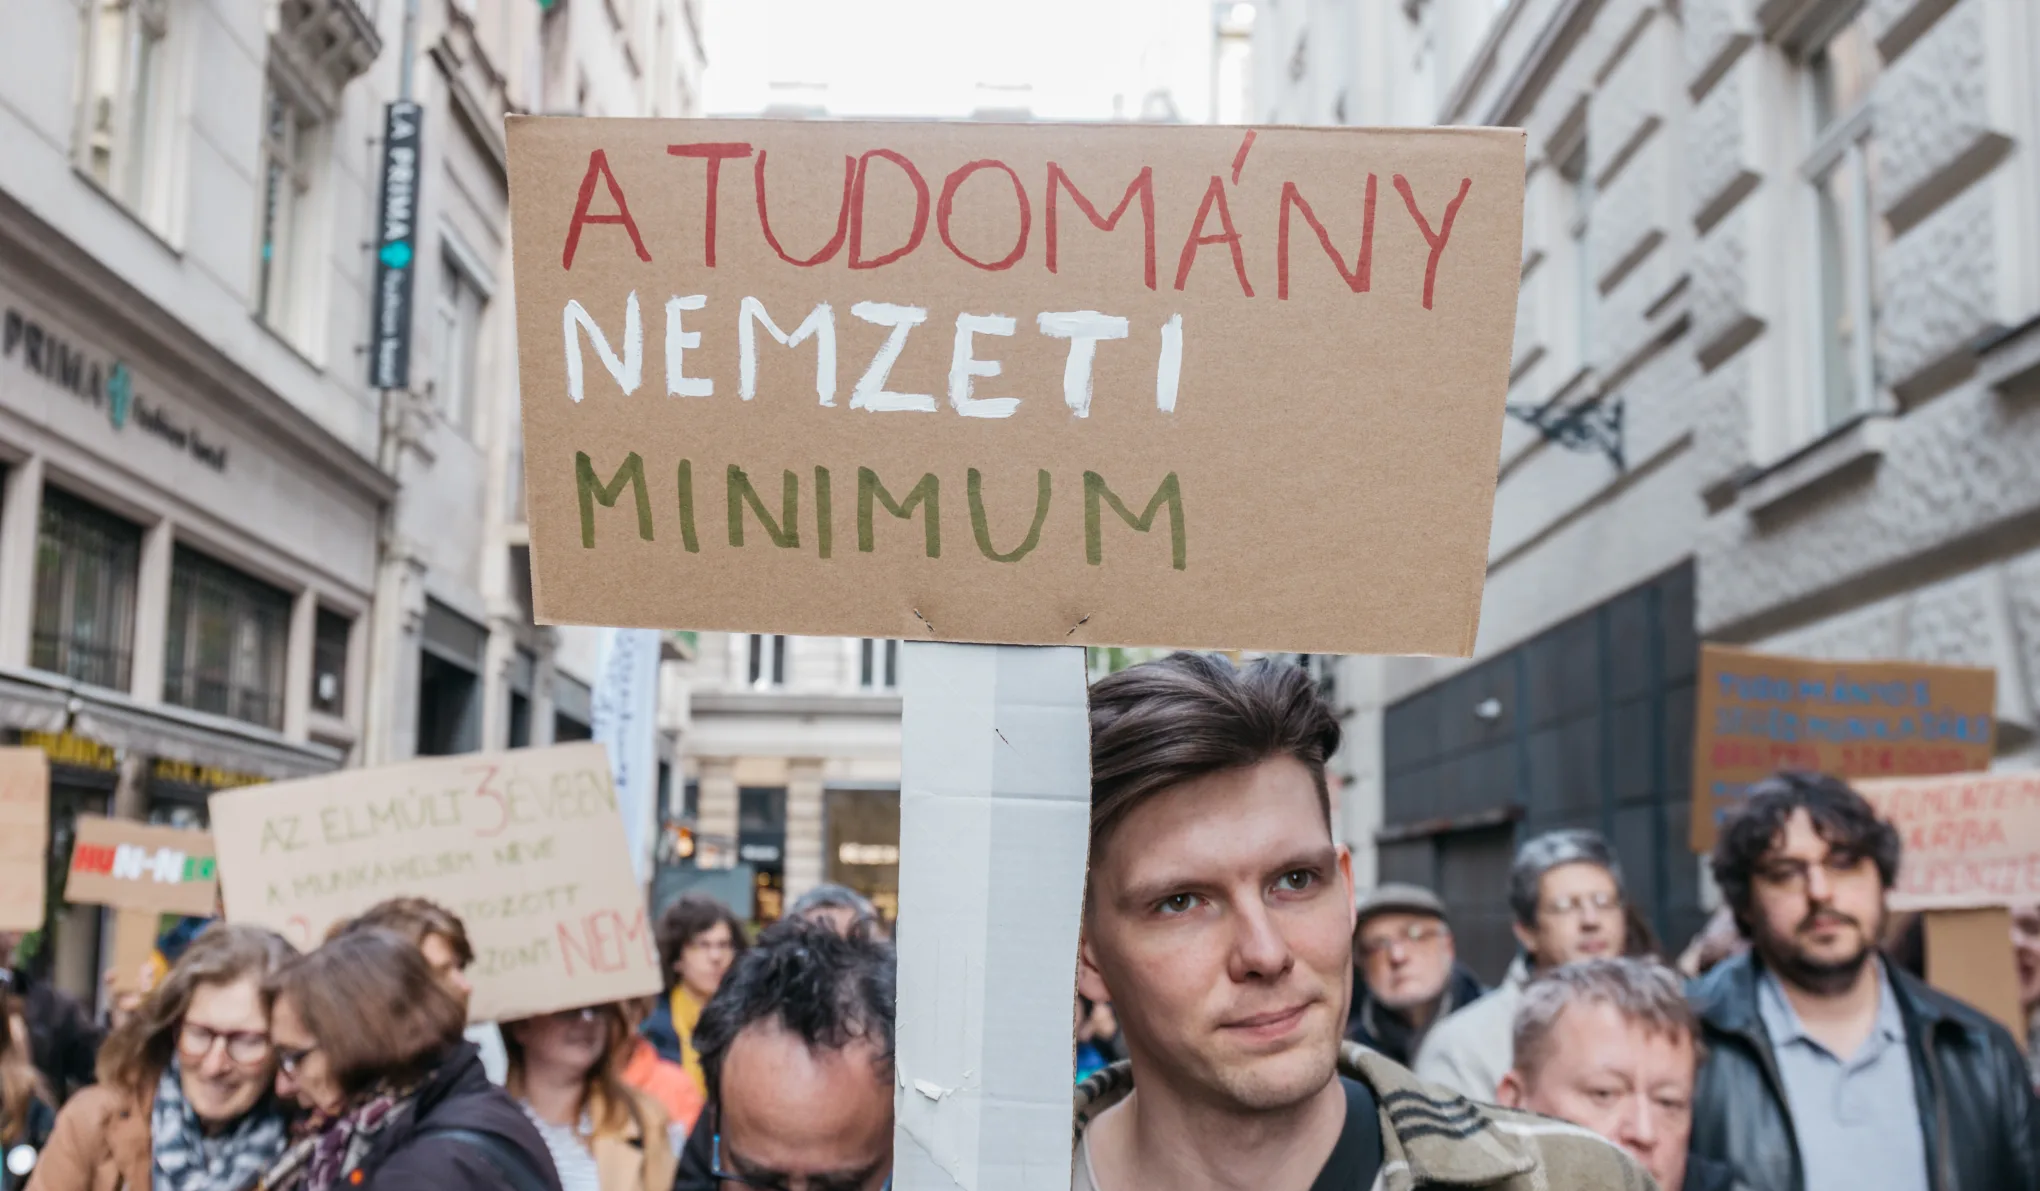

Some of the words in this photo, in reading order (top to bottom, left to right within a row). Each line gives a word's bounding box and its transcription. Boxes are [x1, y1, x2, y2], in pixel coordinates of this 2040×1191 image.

[384, 146, 416, 241] PRIMA
[563, 148, 652, 270] A
[667, 130, 1473, 310] TUDOMÁNY
[4, 305, 106, 410] PRIMA
[563, 290, 1184, 418] NEMZETI
[575, 450, 1187, 570] MINIMUM
[260, 814, 307, 855] AZ
[462, 764, 510, 838] 3
[556, 905, 656, 980] NEM
